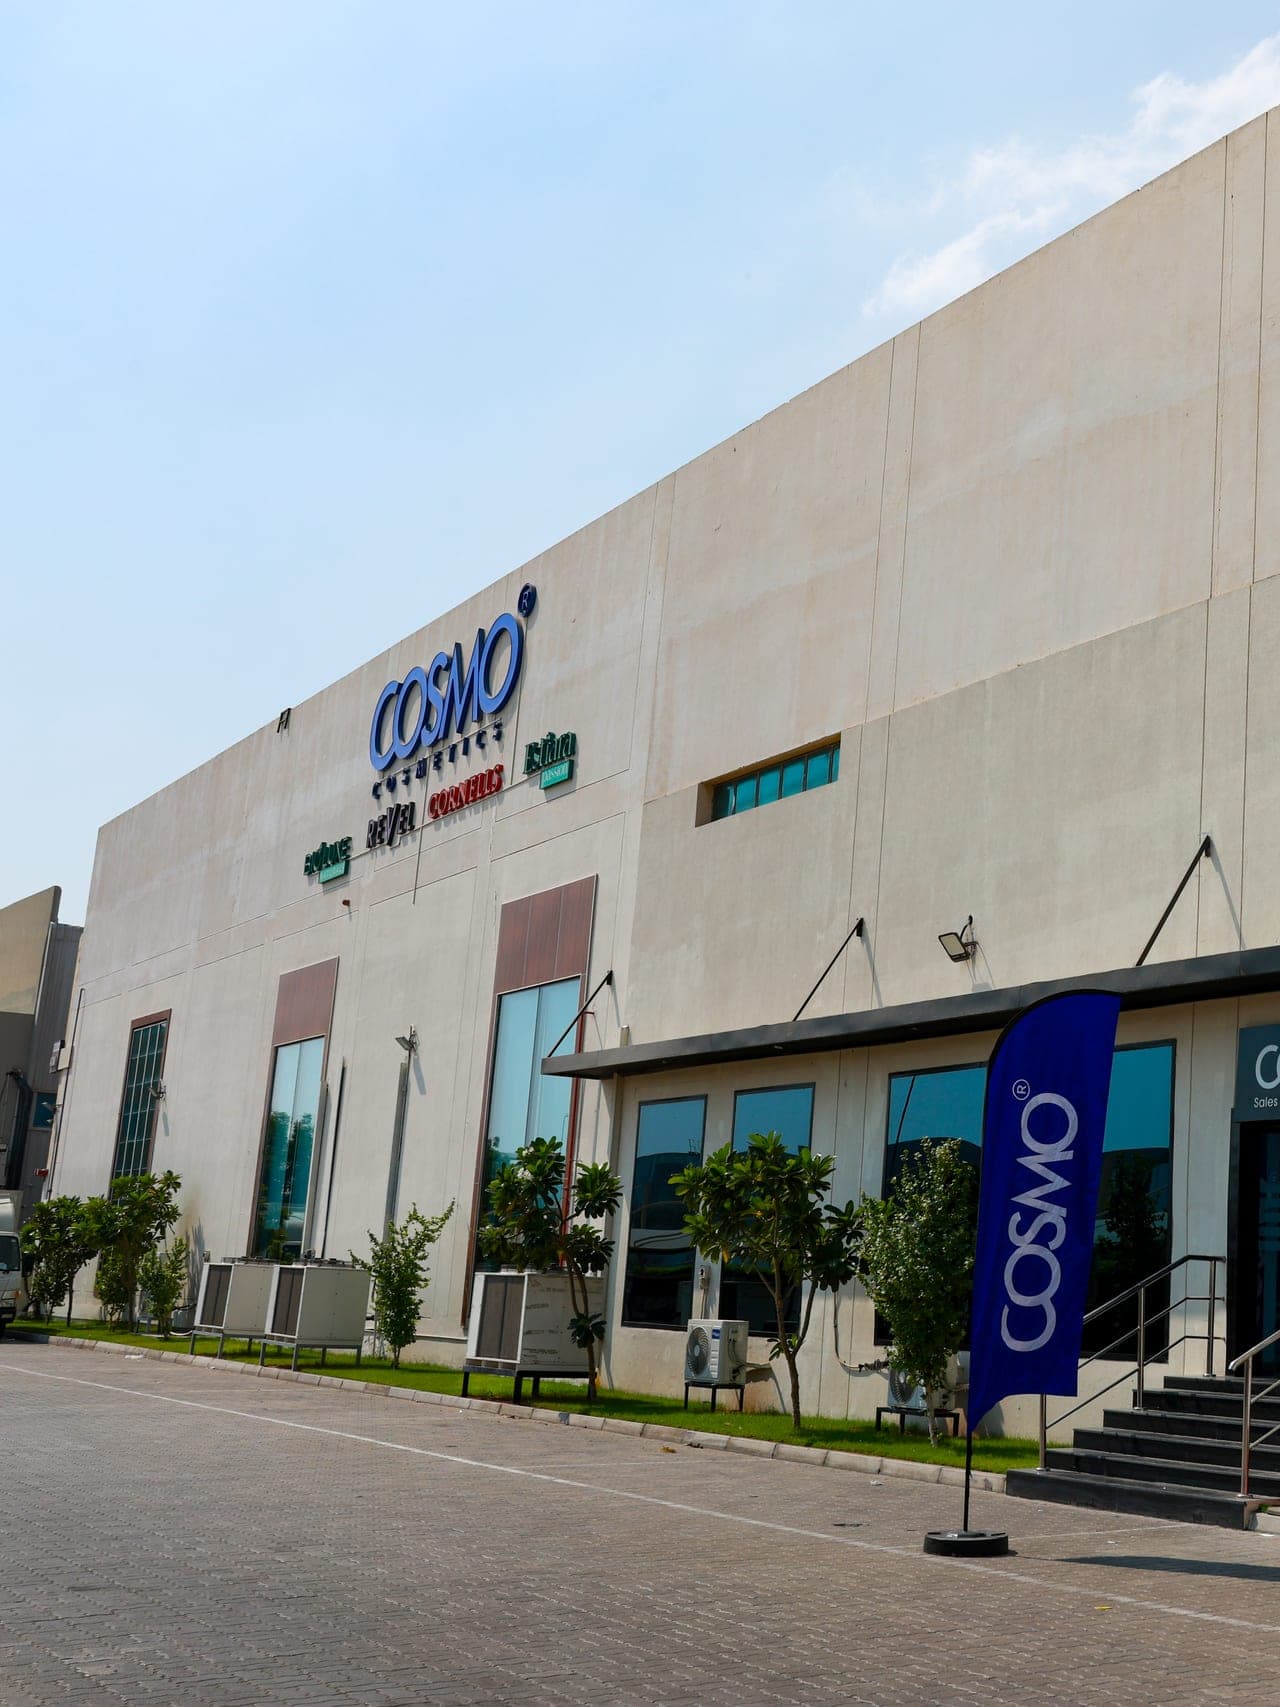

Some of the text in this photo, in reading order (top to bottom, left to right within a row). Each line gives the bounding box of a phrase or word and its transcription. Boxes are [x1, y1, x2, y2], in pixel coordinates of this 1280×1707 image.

[369, 612, 525, 772] COSMO
[371, 720, 503, 800] COSMETICS
[428, 764, 504, 820] CORNELLS
[365, 801, 416, 849] REVEL
[1253, 1096, 1278, 1109] Sales
[1001, 1092, 1078, 1352] COSMO
